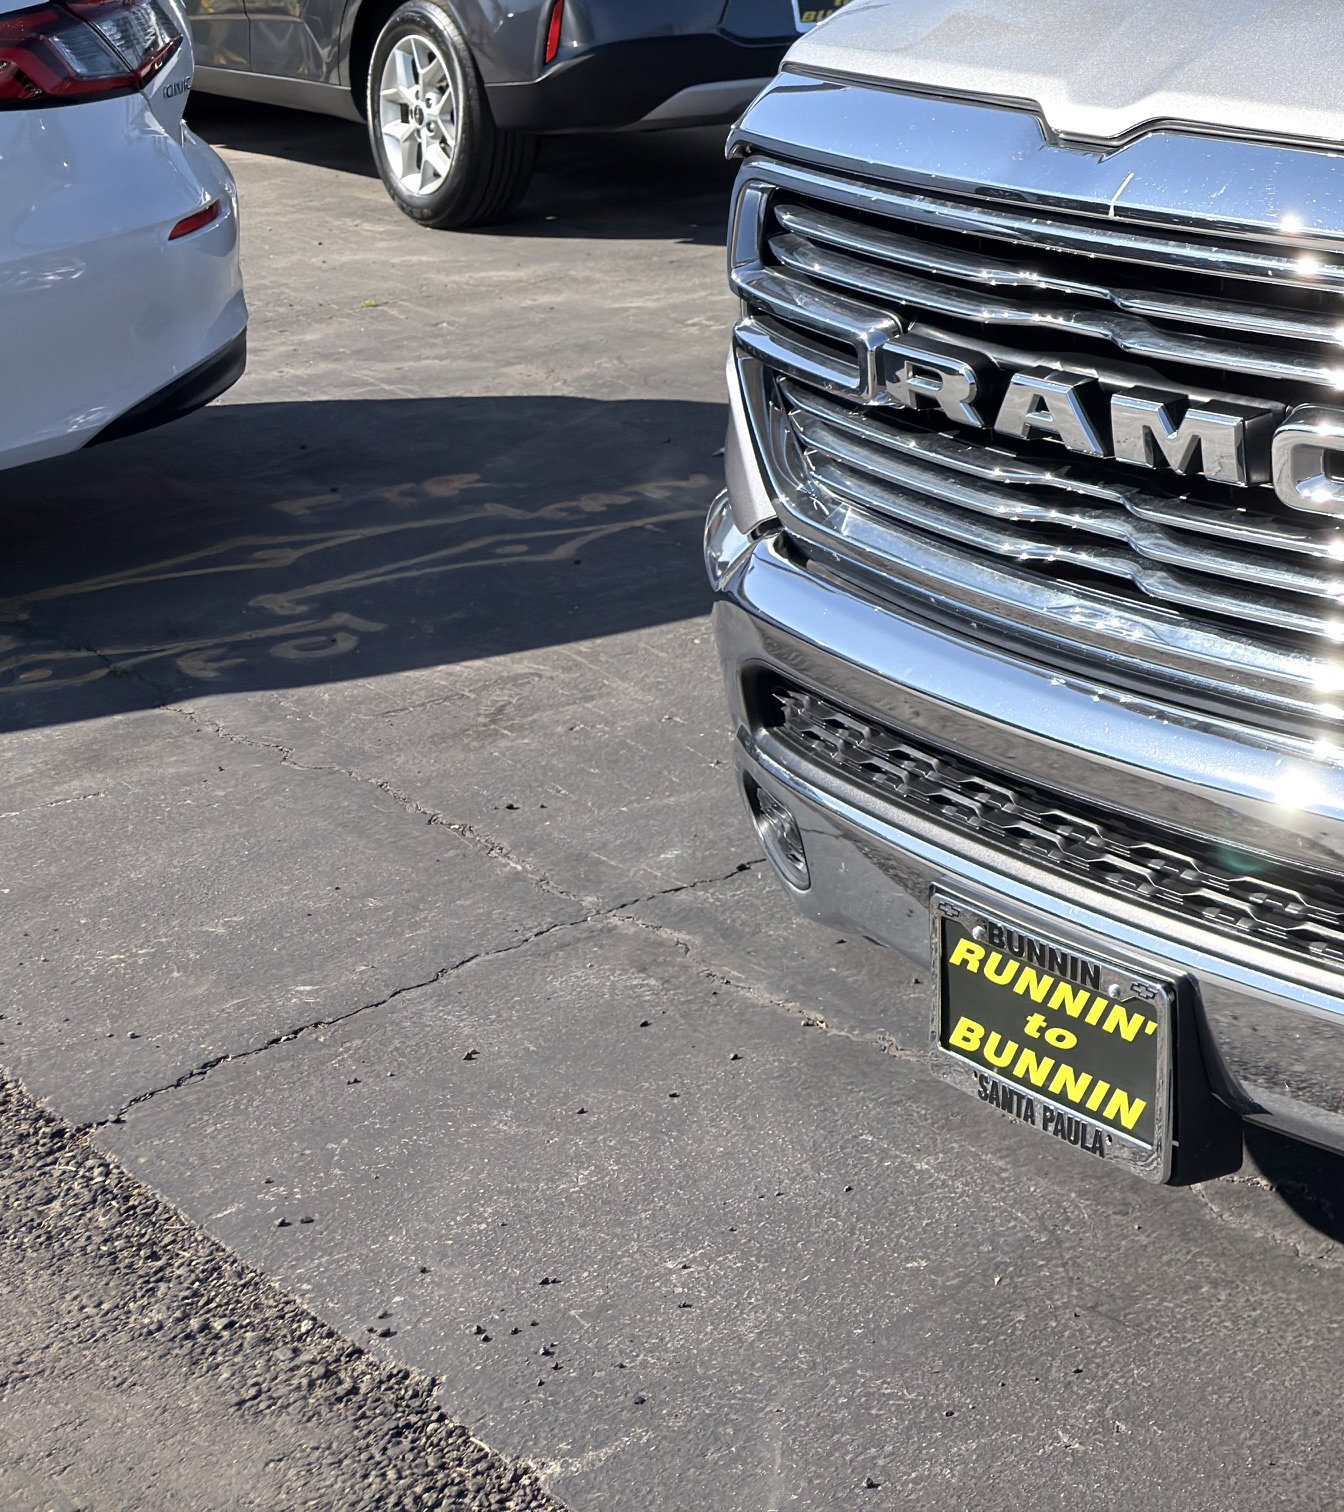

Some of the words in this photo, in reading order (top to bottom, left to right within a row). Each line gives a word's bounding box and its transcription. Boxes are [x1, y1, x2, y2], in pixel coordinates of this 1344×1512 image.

[882, 337, 1262, 486] RAM
[949, 937, 1158, 1043] RUNNIN'
[987, 922, 1101, 990] BUNNIN
[948, 1016, 1147, 1130] BUNNIN
[1023, 1013, 1078, 1050] to
[978, 1073, 1036, 1128] SANTA
[1042, 1105, 1105, 1159] PAULA
